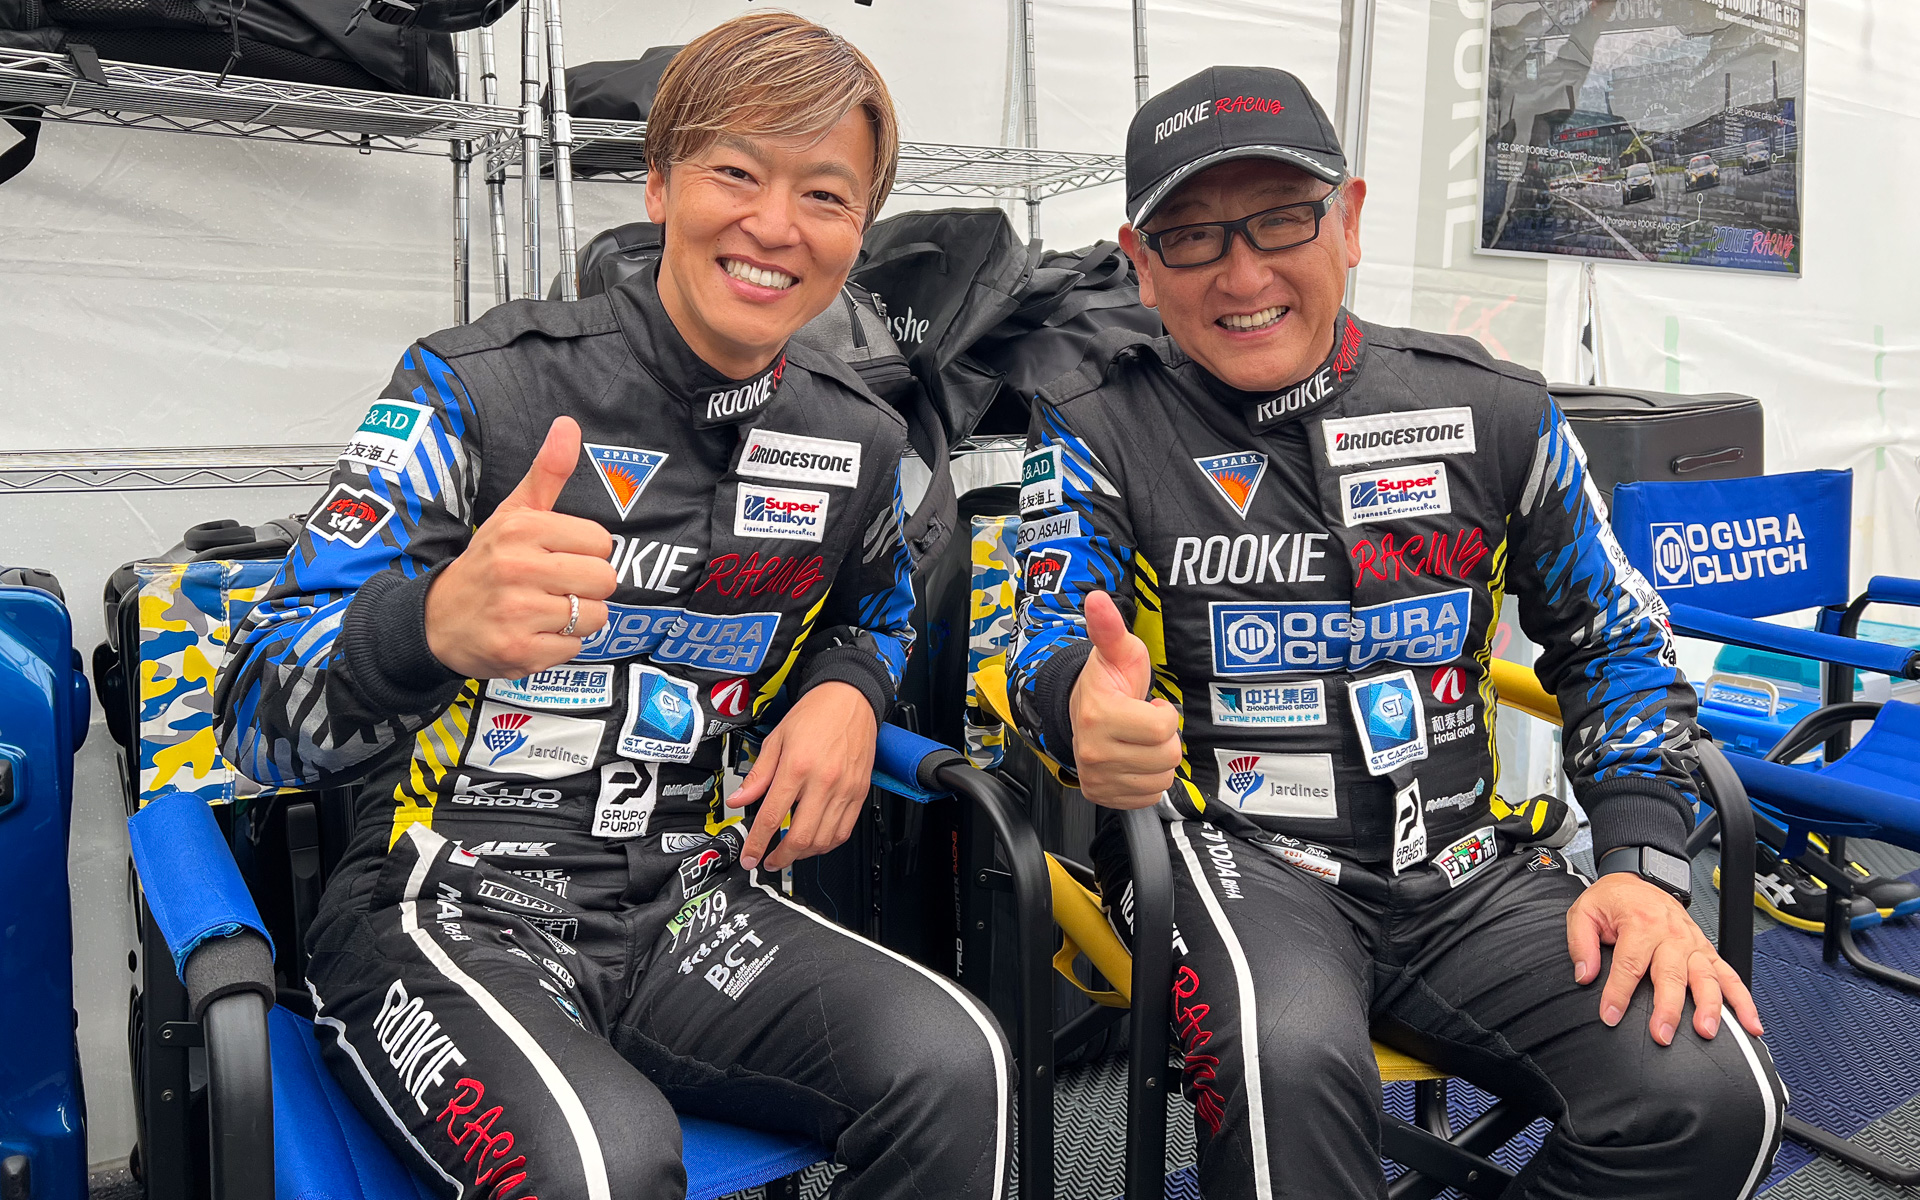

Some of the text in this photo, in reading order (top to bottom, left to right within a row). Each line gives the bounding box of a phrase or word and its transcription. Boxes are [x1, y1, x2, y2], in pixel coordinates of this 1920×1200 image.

[1761, 0, 1782, 22] AMG
[1783, 6, 1800, 28] GT3
[1154, 95, 1285, 144] ROOKIE RACING
[1497, 142, 1510, 152] #32
[1510, 144, 1525, 153] ORC
[1526, 145, 1549, 156] ROOKIE
[1588, 155, 1611, 166] concept
[1638, 220, 1656, 229] ROOKIE
[1708, 226, 1751, 255] ROOKIE
[1751, 230, 1796, 259] RACING
[887, 306, 930, 344] she
[706, 371, 773, 419] ROOKIE
[1257, 367, 1333, 422] ROOKIE
[1336, 423, 1465, 451] BRIDGESTONE
[603, 450, 651, 463] SPARX
[747, 444, 852, 473] BRIDGESTONE
[1212, 455, 1257, 467] SPARX
[1377, 475, 1437, 494] Super
[765, 497, 819, 514] Super
[1378, 488, 1437, 505] Taikyu
[764, 510, 816, 526] Taikyu
[1037, 519, 1071, 540] ASAHI
[1686, 513, 1805, 552] OGURA
[1169, 527, 1488, 588] ROOKIE RACING
[1692, 543, 1808, 585] CLUTCH
[695, 551, 824, 599] RACING
[618, 614, 763, 643] OGURA
[1283, 602, 1460, 642] OGURA
[607, 636, 759, 666] CLUTCH
[1284, 628, 1458, 665] CLUTCH
[531, 684, 605, 694] ZHONGSHENG GROUP
[533, 670, 608, 688] 中升集团
[495, 689, 531, 702] LIFETIME
[1245, 688, 1318, 705] 中升集团
[1246, 703, 1319, 712] ZHONGSHENG GROUP
[1219, 715, 1250, 723] LIFETIME
[1457, 723, 1476, 738] Group
[528, 745, 588, 766] Jardines
[624, 738, 691, 755] GT CAPITAL
[1371, 742, 1424, 765] GT CAPITAL
[1271, 782, 1329, 798] Jardines
[451, 794, 559, 809] GROUP
[602, 809, 647, 821] GRUPO
[600, 821, 643, 832] PURDY
[1395, 848, 1423, 867] PURDY
[1396, 835, 1425, 858] GRUPO
[1443, 836, 1496, 879] ジャンボ
[704, 930, 763, 991] BCT
[372, 979, 467, 1116] ROOKIE
